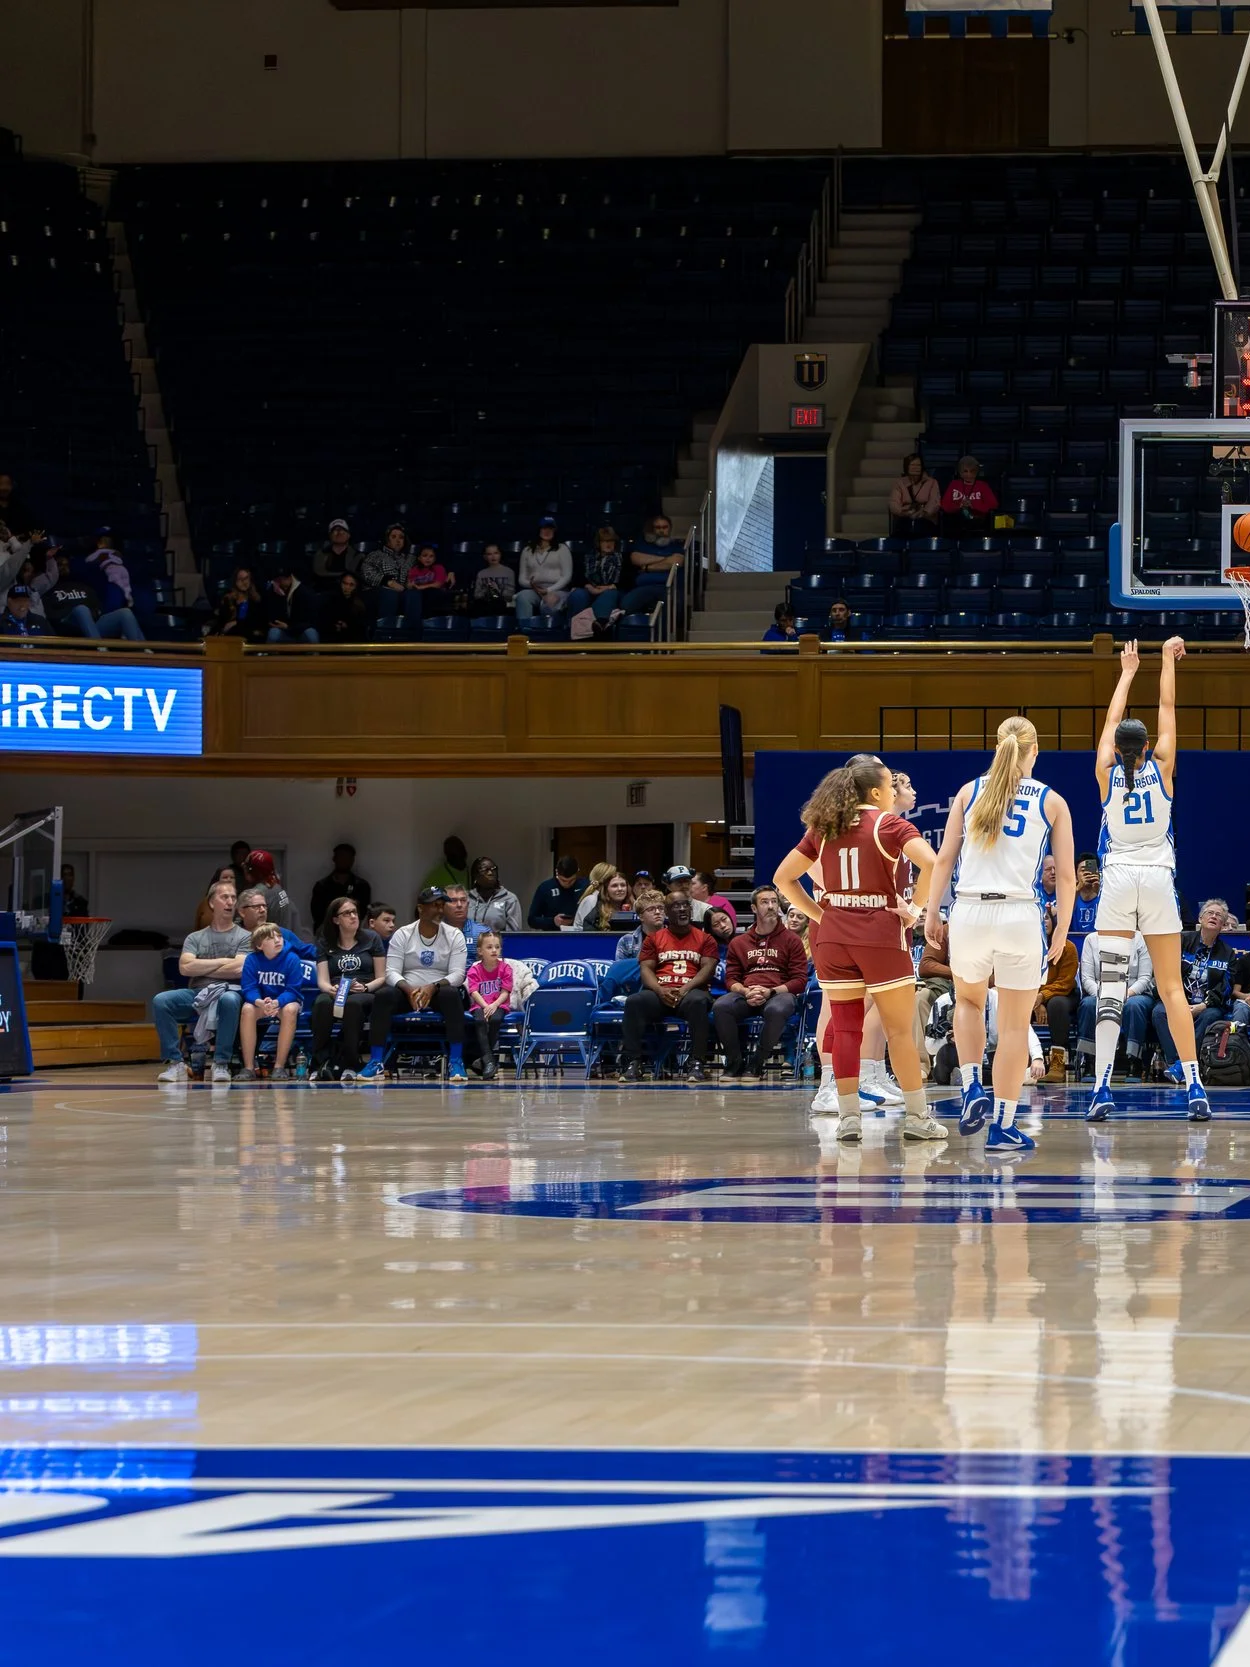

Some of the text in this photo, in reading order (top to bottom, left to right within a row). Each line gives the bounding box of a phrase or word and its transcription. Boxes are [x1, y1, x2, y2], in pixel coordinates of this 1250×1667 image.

[802, 363, 819, 383] 11
[795, 407, 819, 425] EXIT
[54, 589, 88, 601] Duke
[1130, 588, 1161, 596] SPALDING
[1113, 773, 1159, 789] RORSON
[1123, 791, 1155, 825] 21
[838, 847, 860, 890] 11
[823, 893, 888, 908] NDERSON
[747, 949, 778, 960] BOSTON
[547, 963, 585, 982] DUKE
[1212, 960, 1228, 969] DUK
